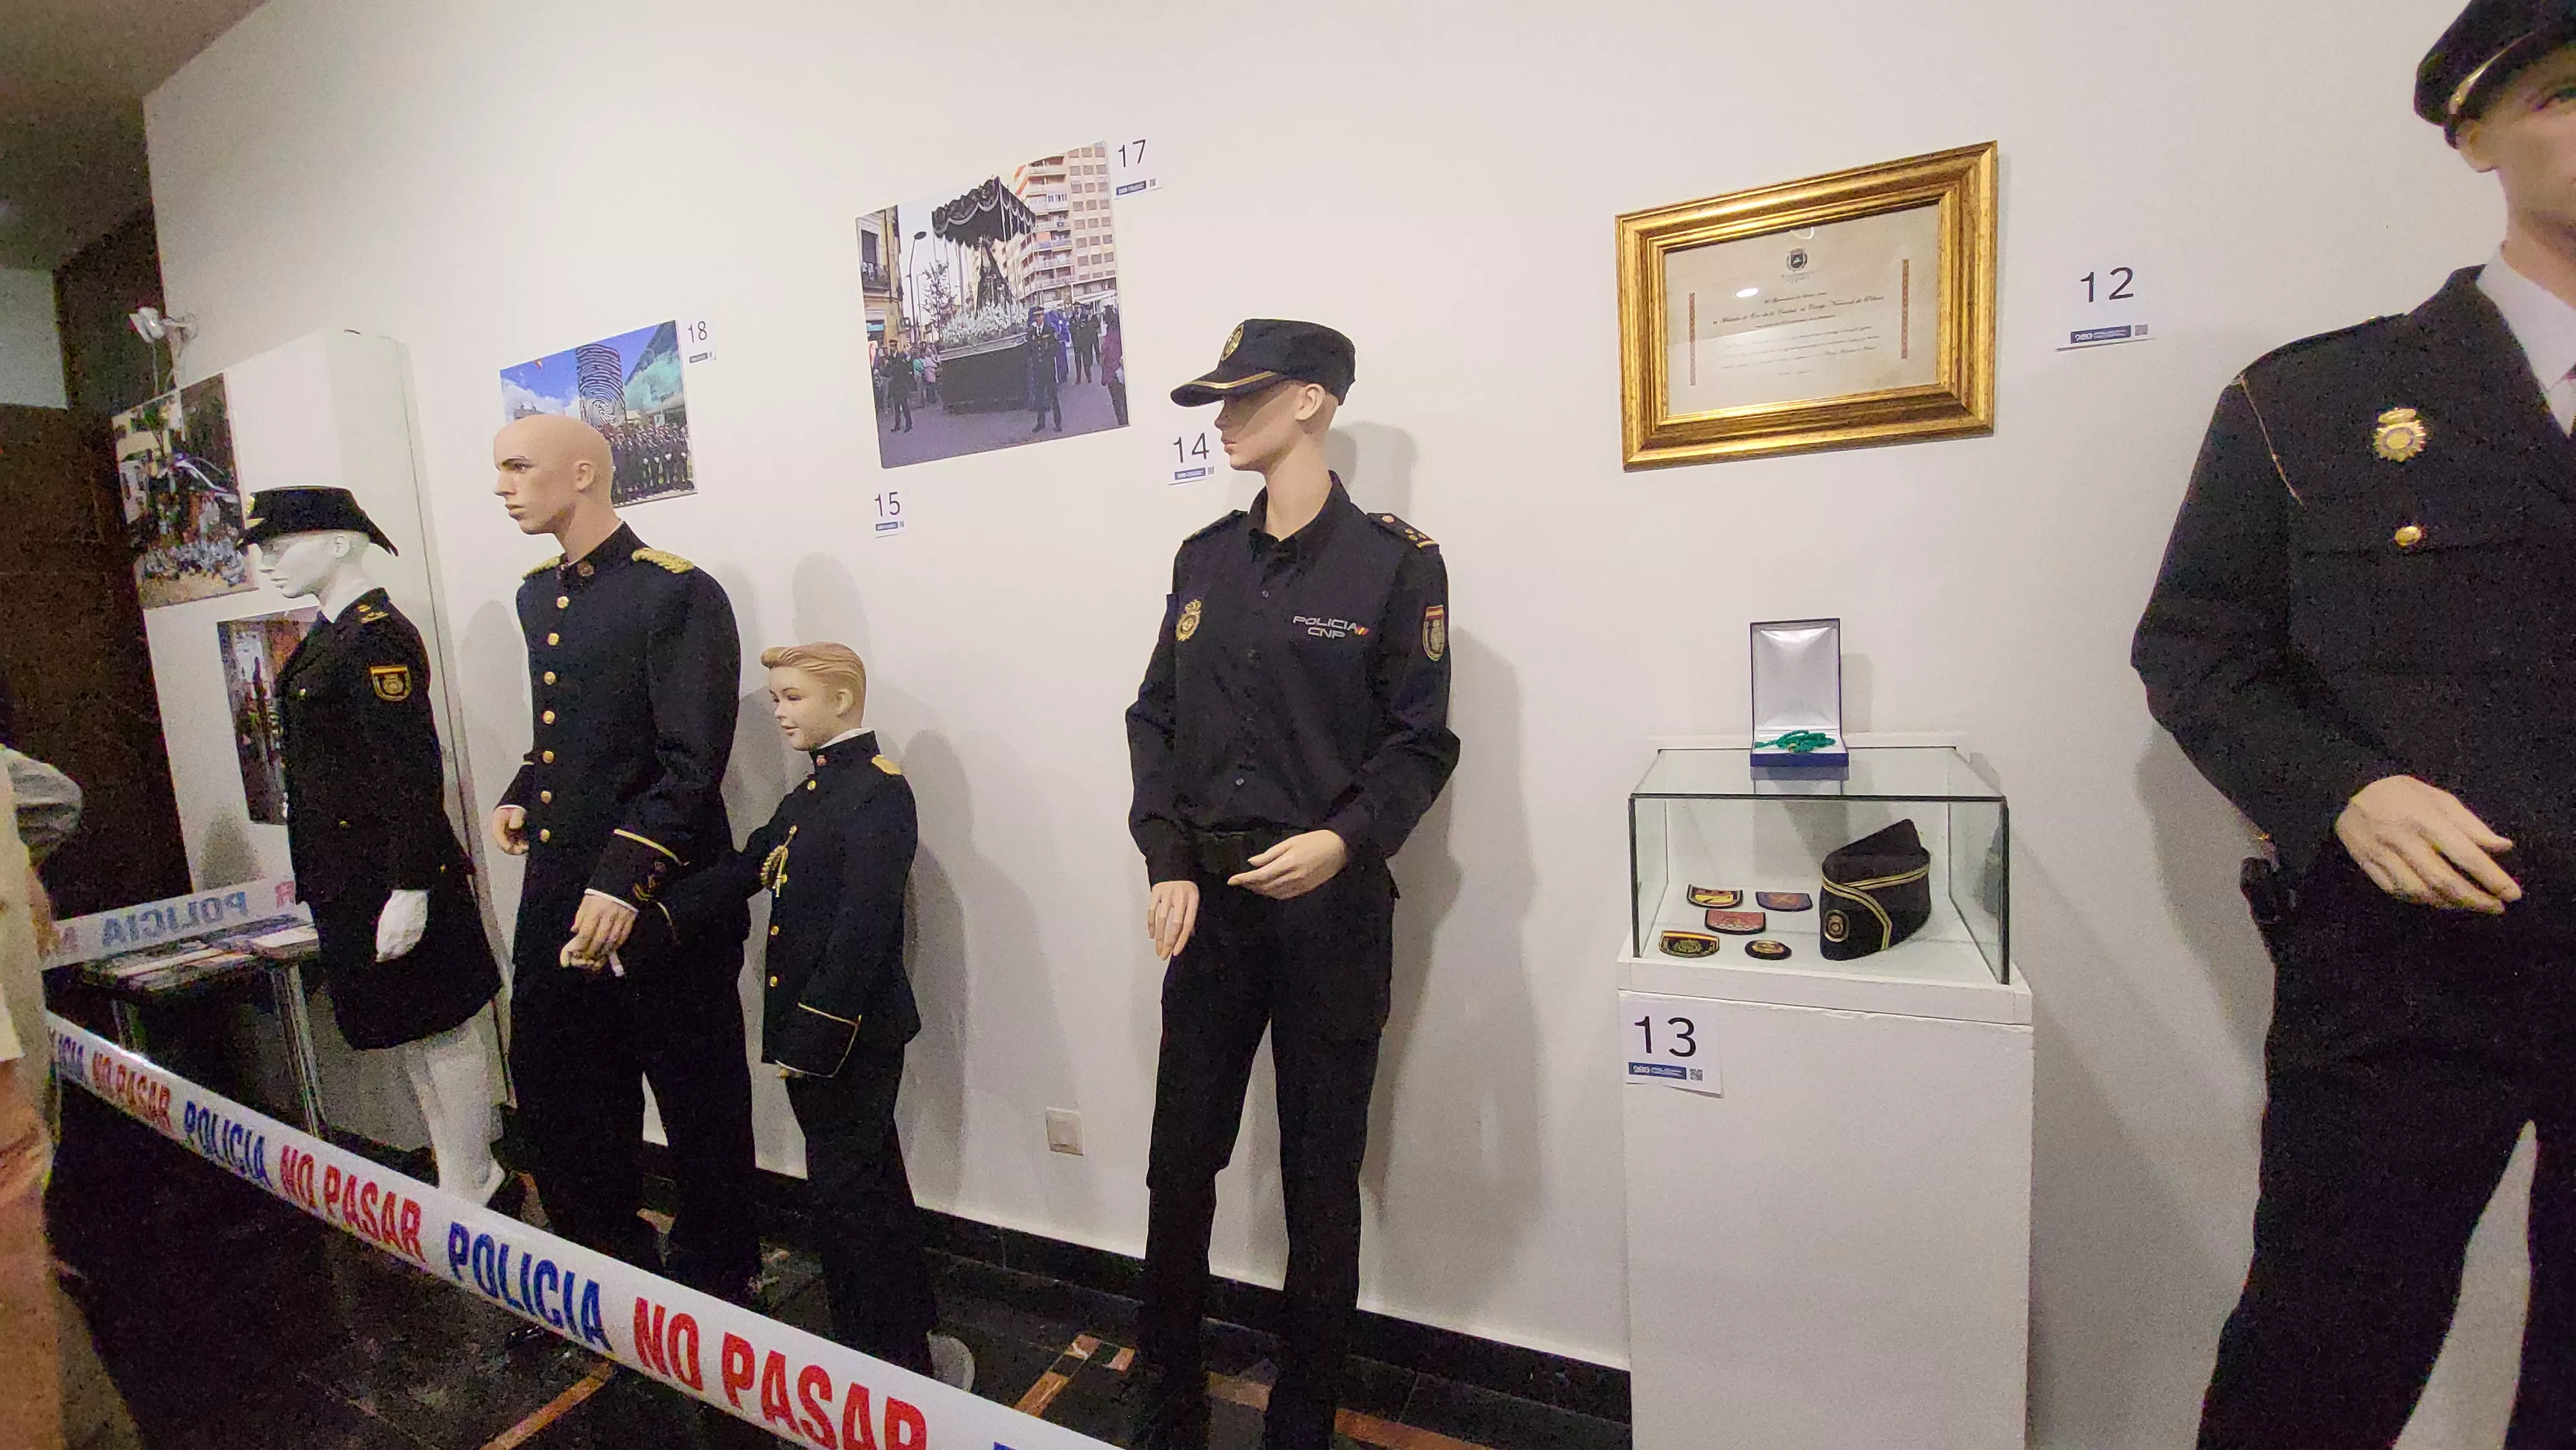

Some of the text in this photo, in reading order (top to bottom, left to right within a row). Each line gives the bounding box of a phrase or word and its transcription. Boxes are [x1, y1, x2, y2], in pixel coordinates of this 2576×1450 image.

[1117, 139, 1146, 167] 17
[2079, 267, 2134, 303] 12
[687, 321, 708, 343] 18
[1173, 432, 1210, 464] 14
[874, 491, 900, 516] 15
[1292, 615, 1358, 635] POLICIA
[1307, 626, 1346, 639] CNP
[1634, 1015, 1696, 1057] 13
[184, 1100, 274, 1189] POLICIA
[279, 1144, 320, 1212] NO
[324, 1165, 428, 1264] PASAR
[448, 1219, 614, 1353] POLICIA
[633, 1296, 704, 1391] NO
